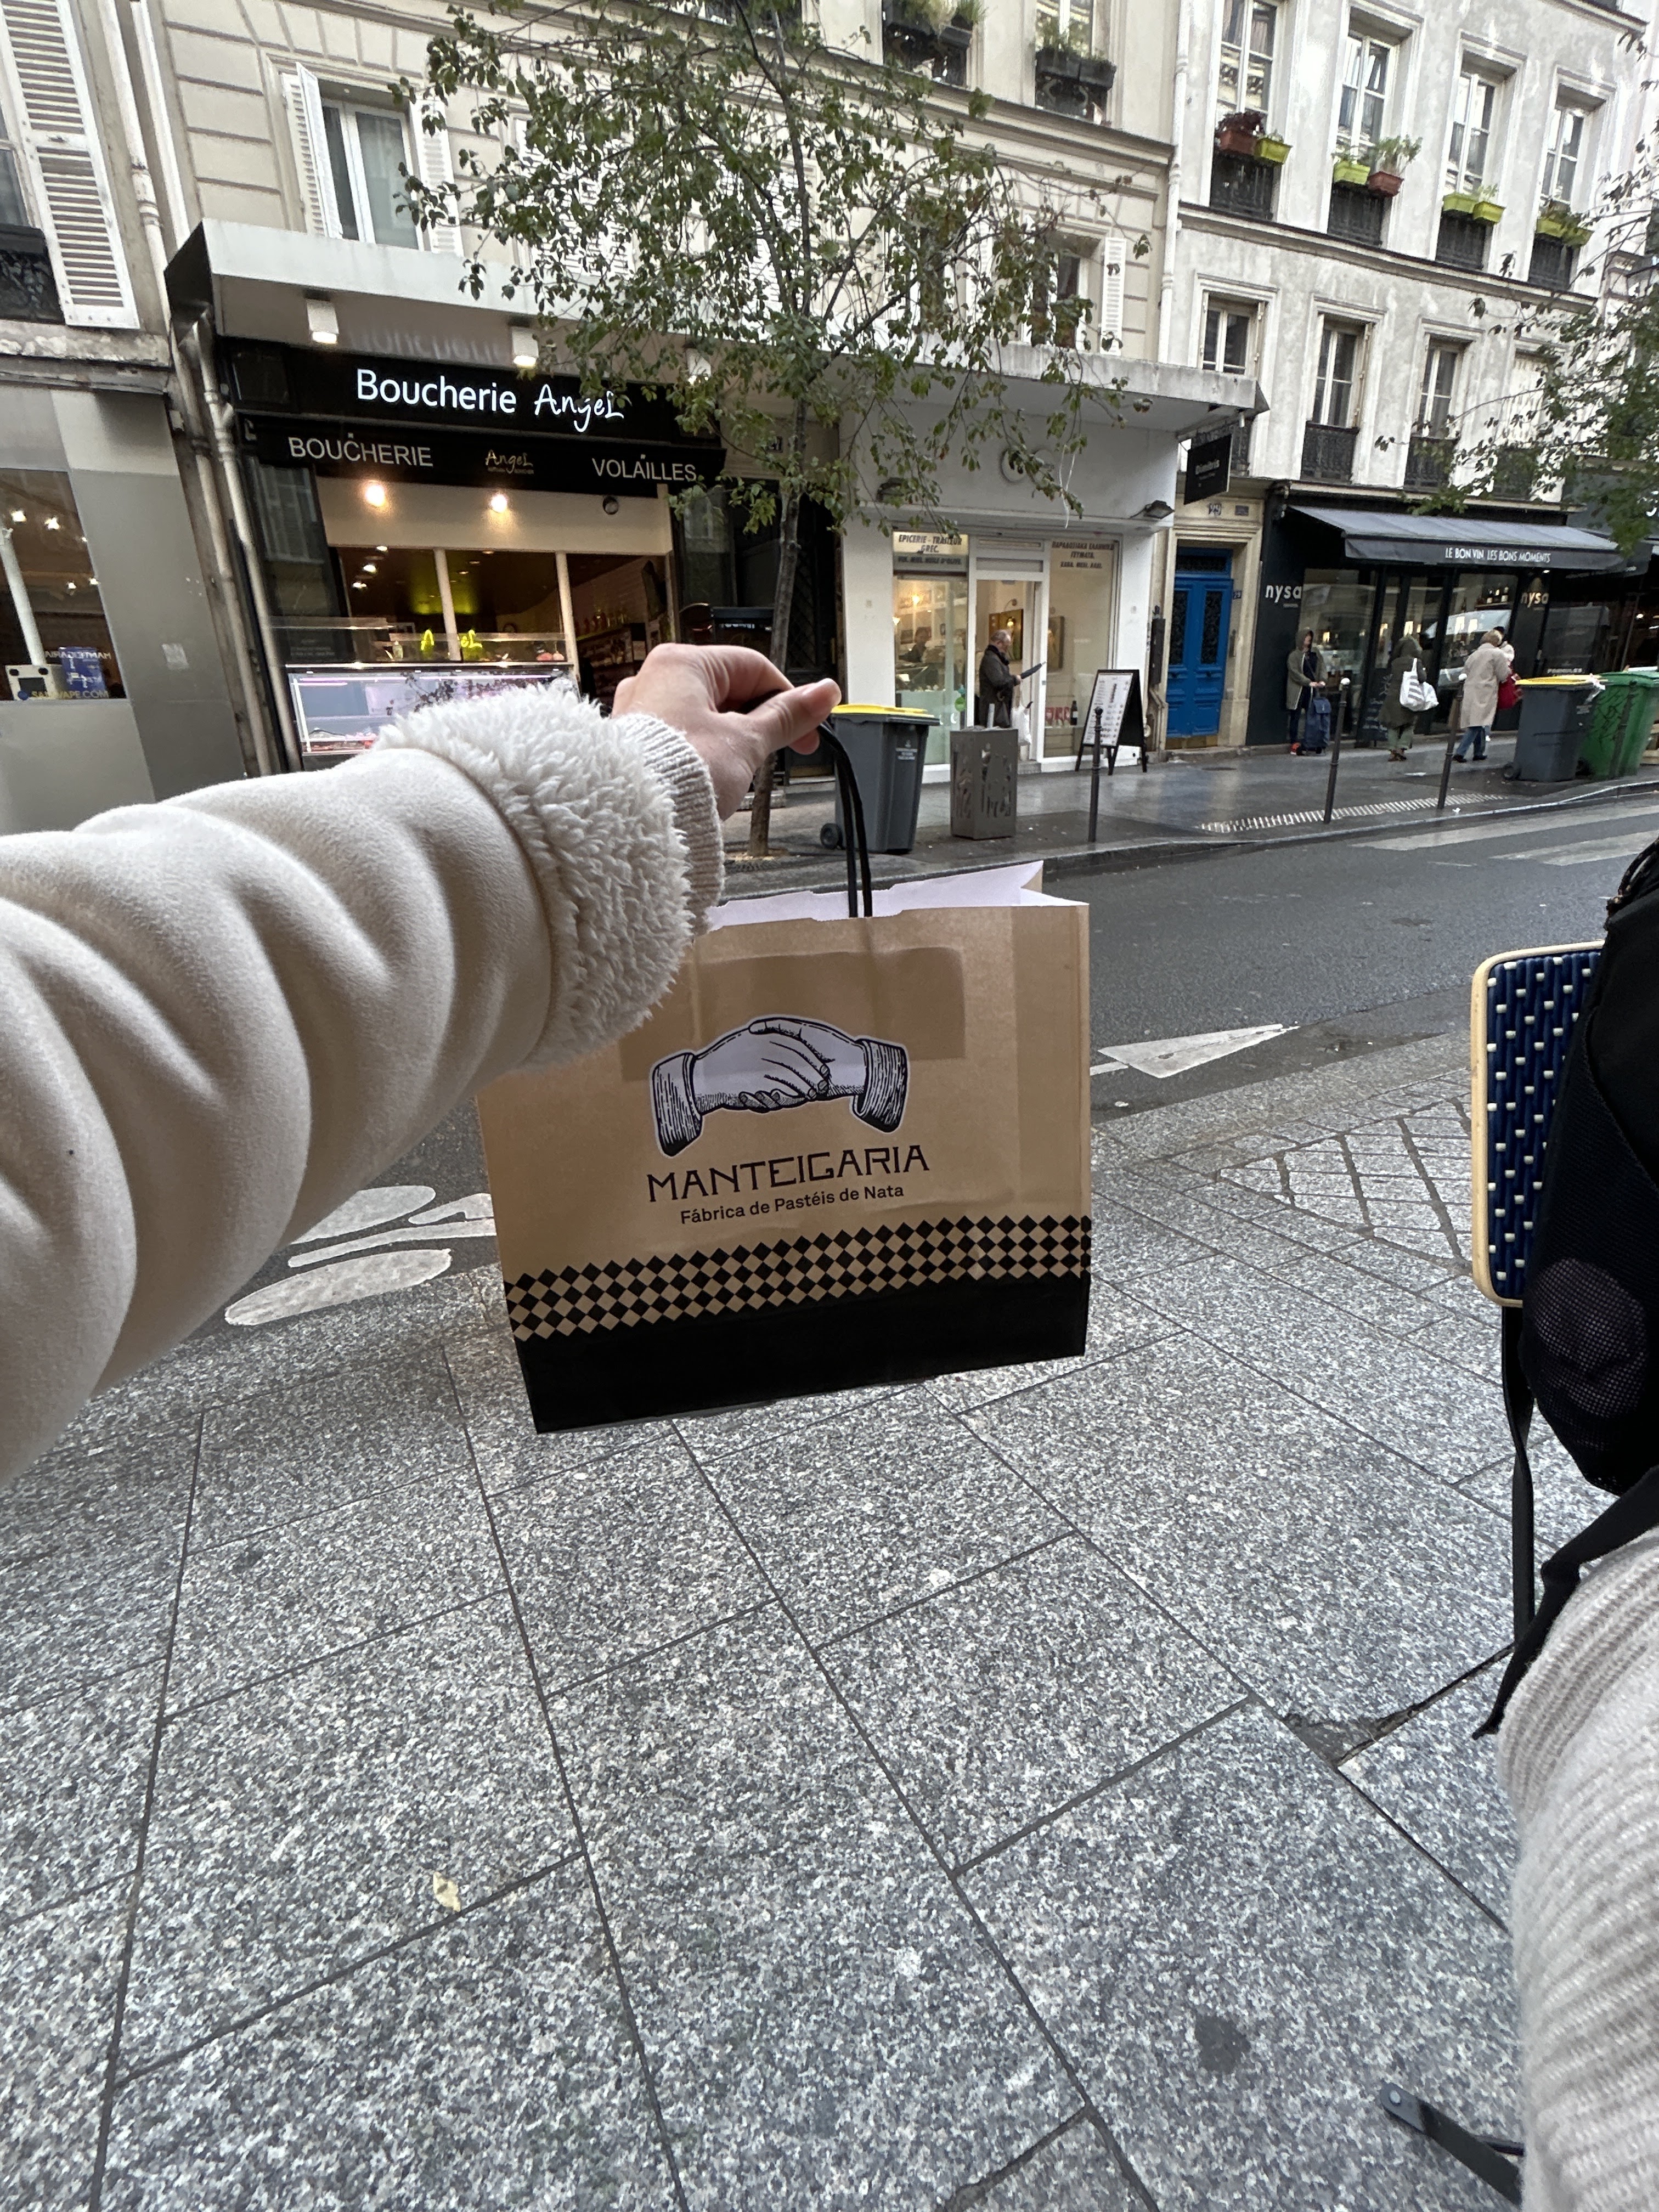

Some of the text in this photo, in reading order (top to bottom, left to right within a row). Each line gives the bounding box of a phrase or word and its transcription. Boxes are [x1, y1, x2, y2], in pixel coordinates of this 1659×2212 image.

[357, 368, 517, 413] Boucherie
[288, 436, 433, 467] BOUCHERIE
[591, 458, 697, 481] VOLAILLES
[899, 534, 927, 543] EPICERIE
[1445, 548, 1453, 558] LE
[1455, 548, 1471, 559] BON
[1487, 550, 1498, 561] LES
[1499, 550, 1518, 562] BONS
[1519, 552, 1551, 563] MOMENTS
[1265, 585, 1302, 603] nysa
[1520, 592, 1550, 608] nysa
[646, 1144, 930, 1203] MANTEIGARIA
[680, 1185, 904, 1224] Fábrica de Pastéis de Nata
